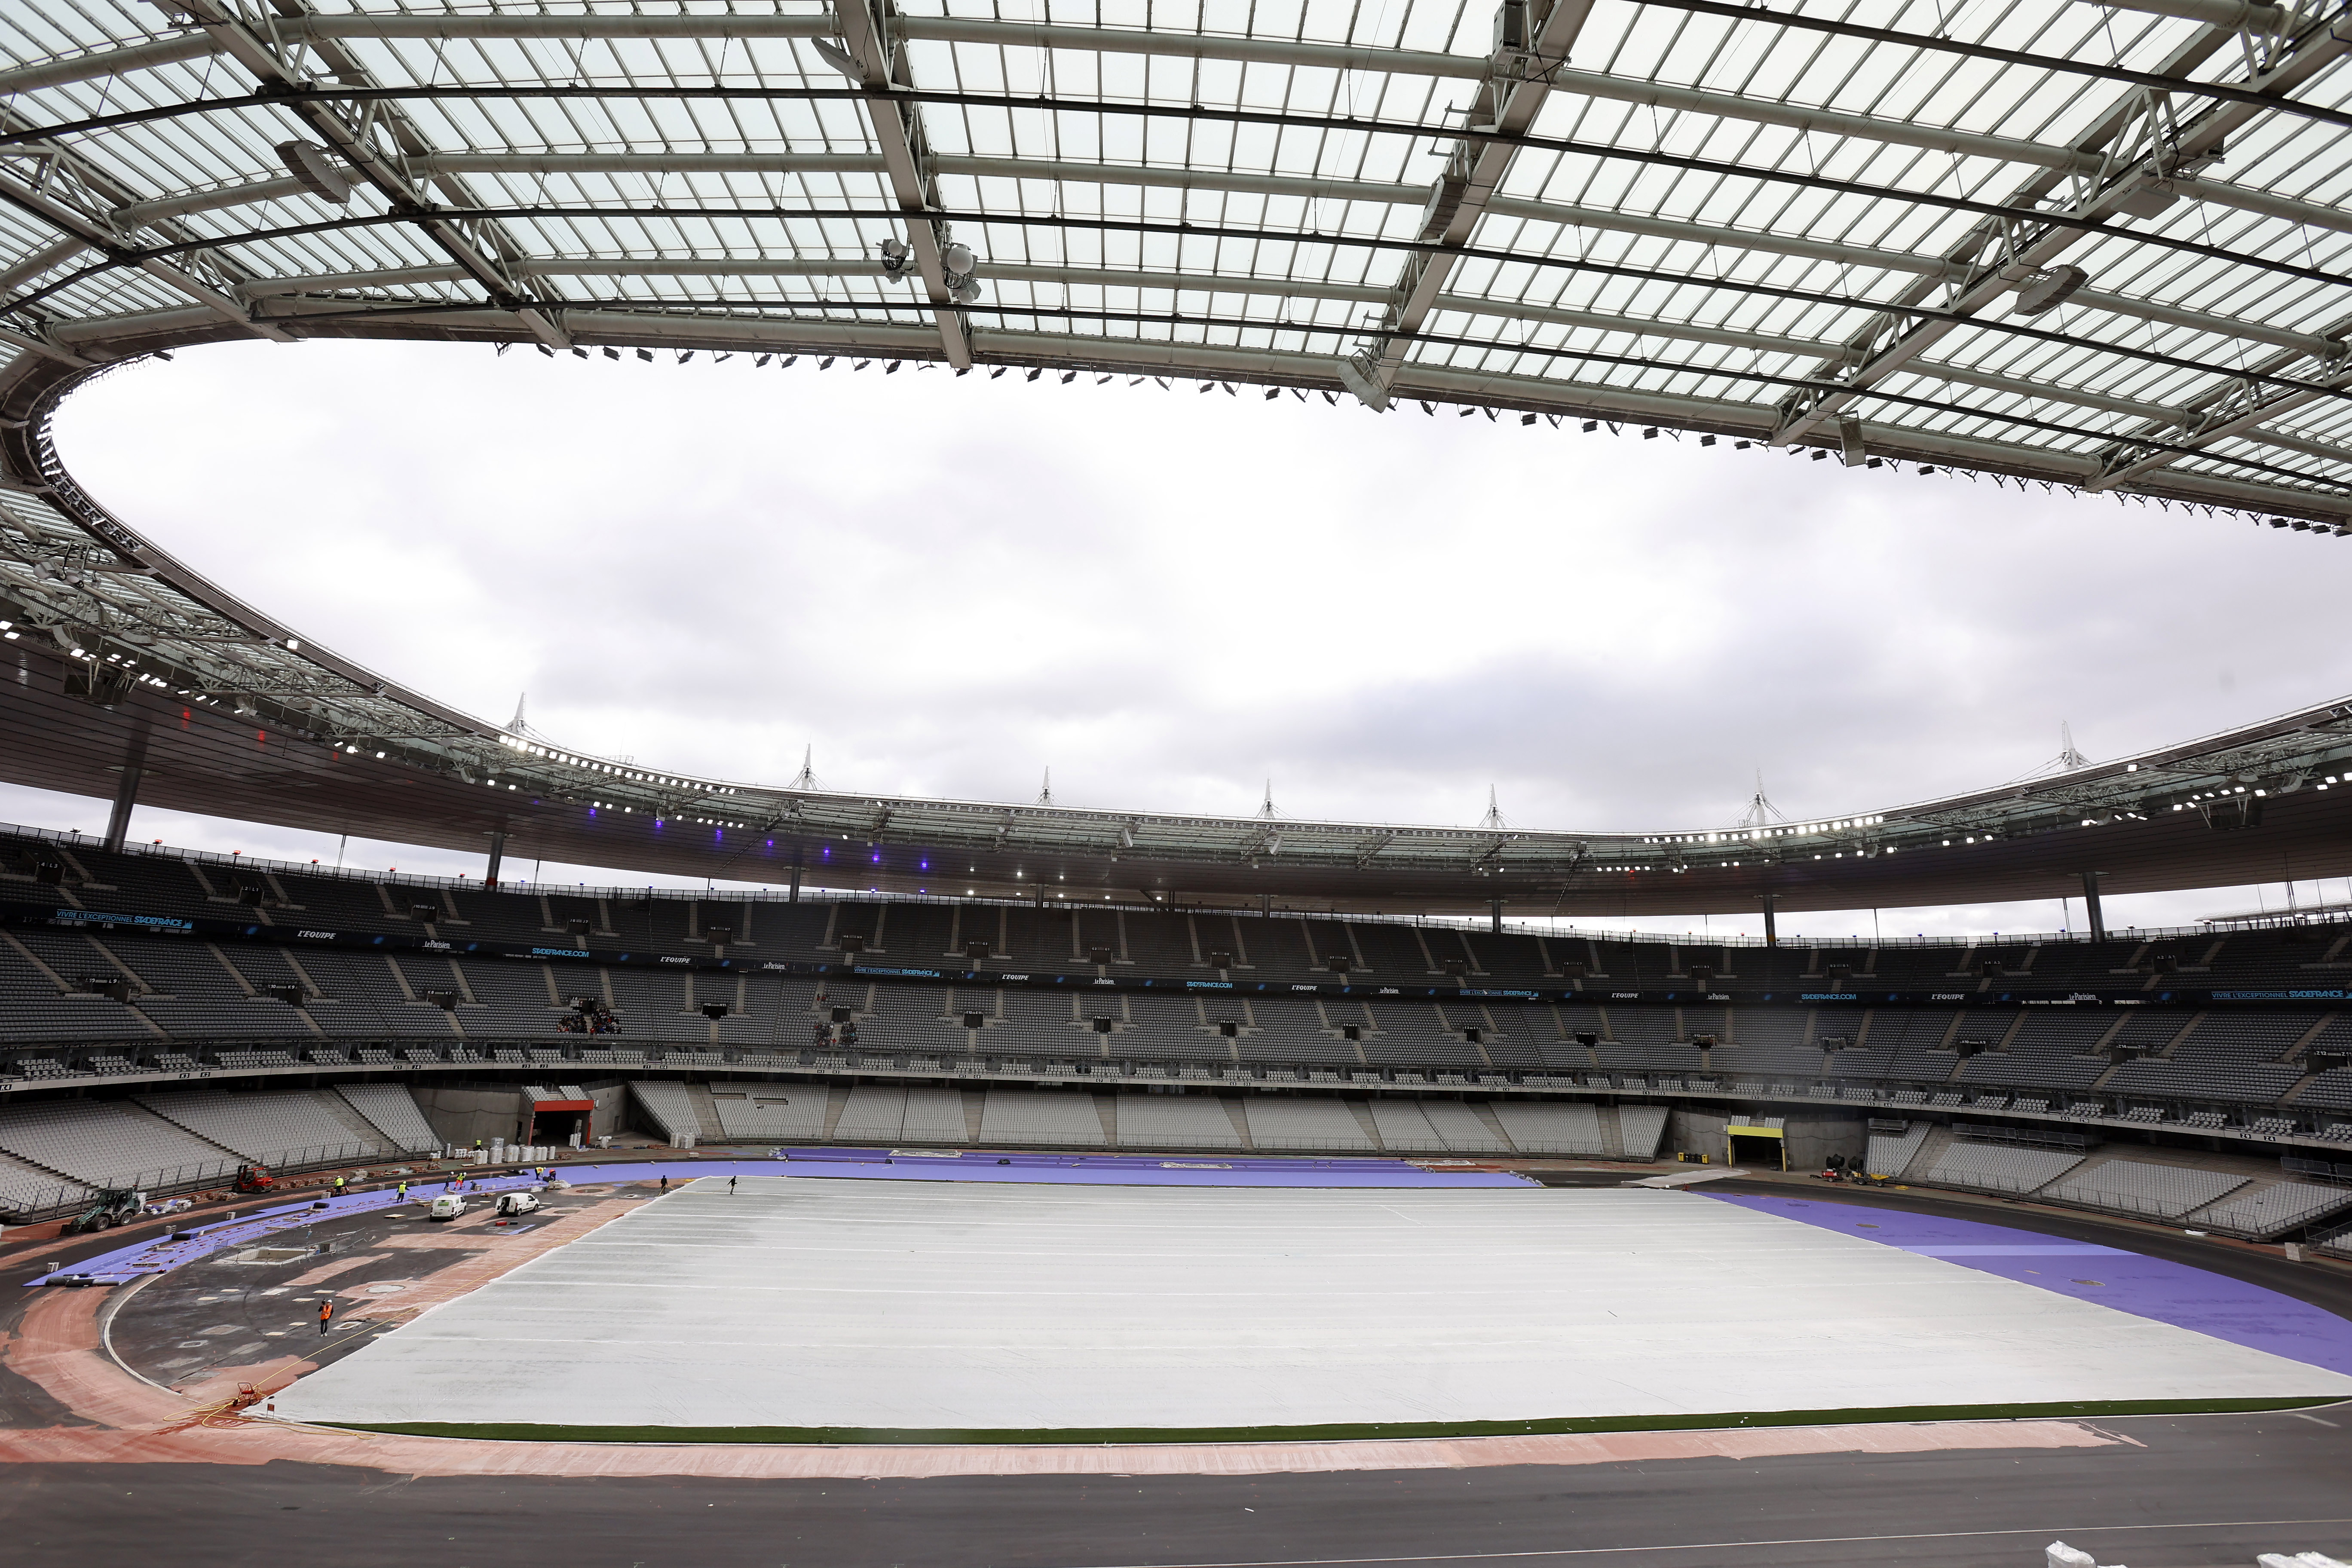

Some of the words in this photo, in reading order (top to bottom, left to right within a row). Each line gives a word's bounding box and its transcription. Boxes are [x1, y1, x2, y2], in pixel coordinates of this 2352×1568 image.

[79, 913, 133, 922] L'EXCEPTIONNEL
[297, 930, 336, 939] L'ÉQUIPE
[430, 940, 450, 948] Parisien
